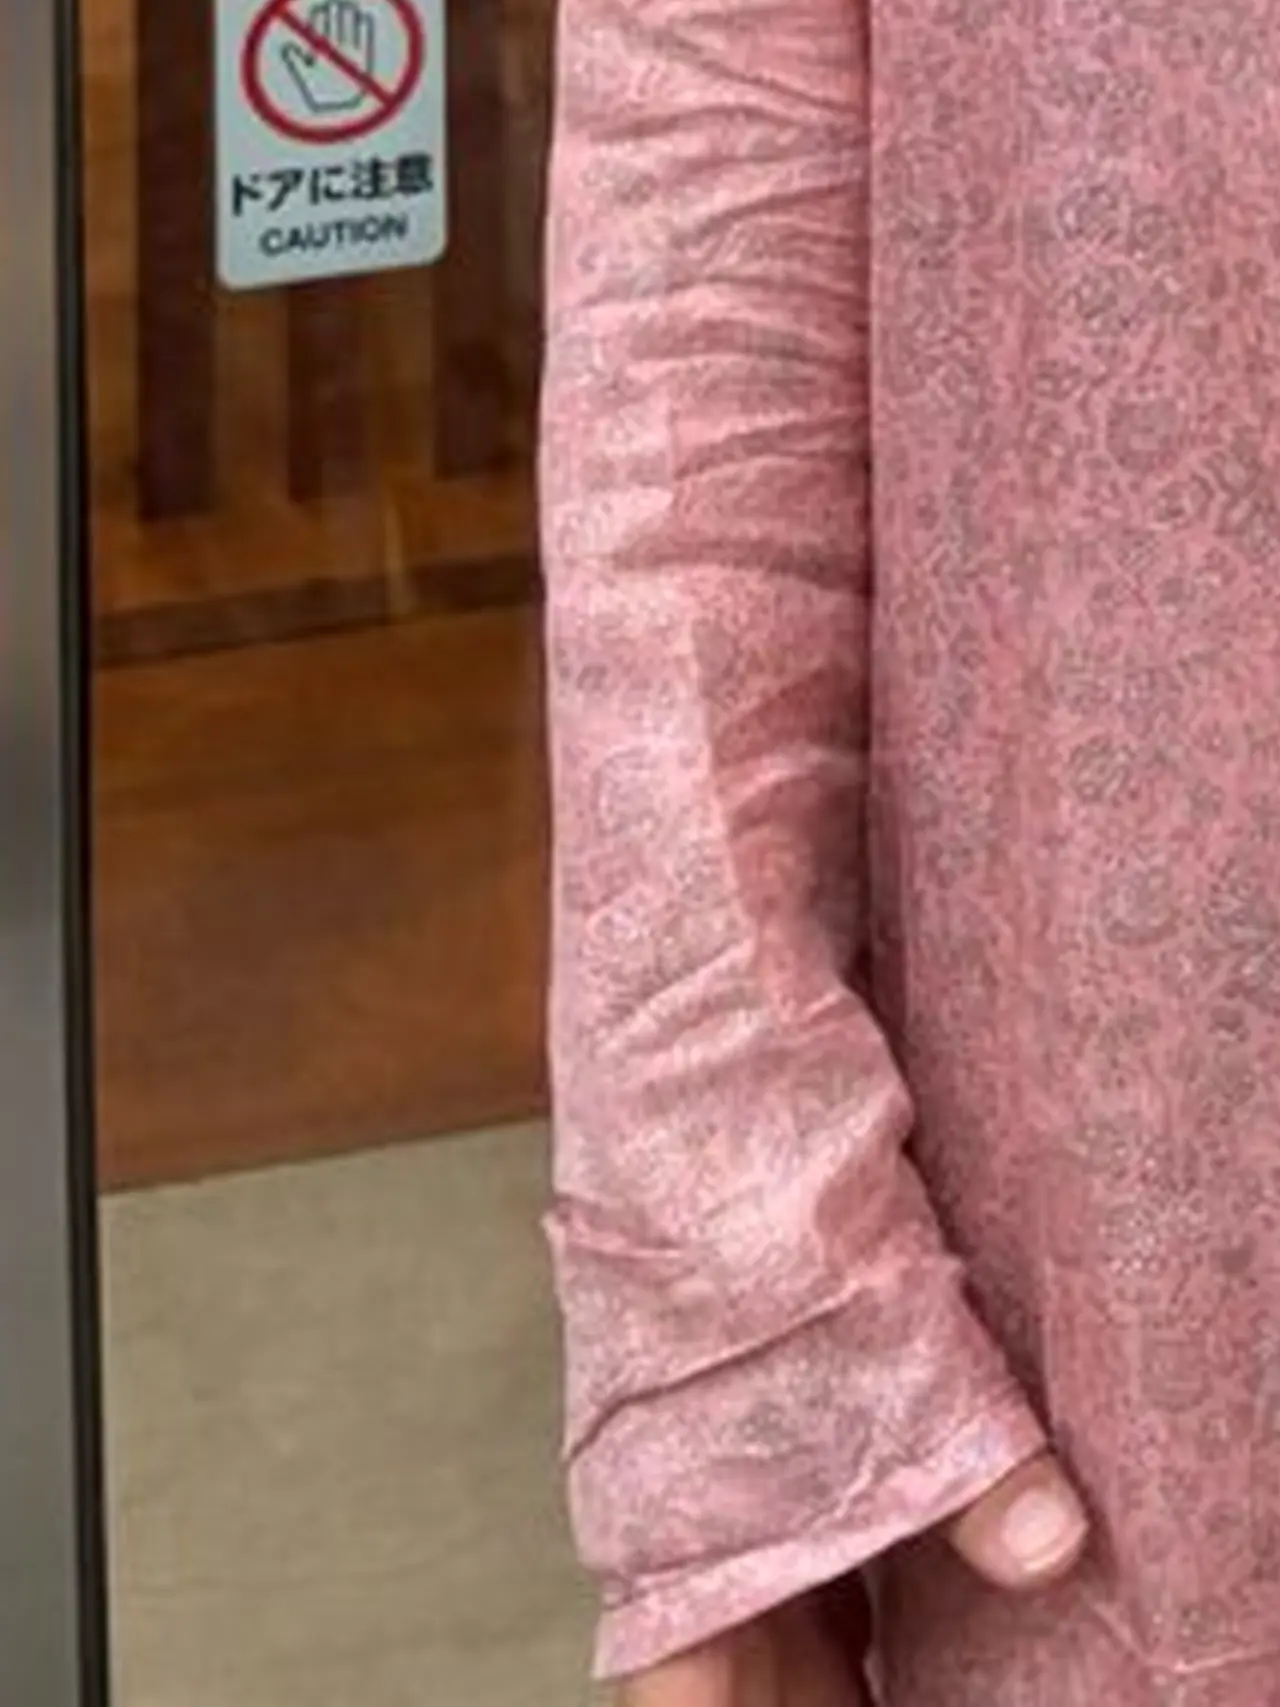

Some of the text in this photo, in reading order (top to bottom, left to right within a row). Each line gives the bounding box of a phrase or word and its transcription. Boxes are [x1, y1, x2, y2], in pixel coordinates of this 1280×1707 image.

[233, 154, 433, 215] ドアに注意
[260, 217, 408, 256] CAUTION
